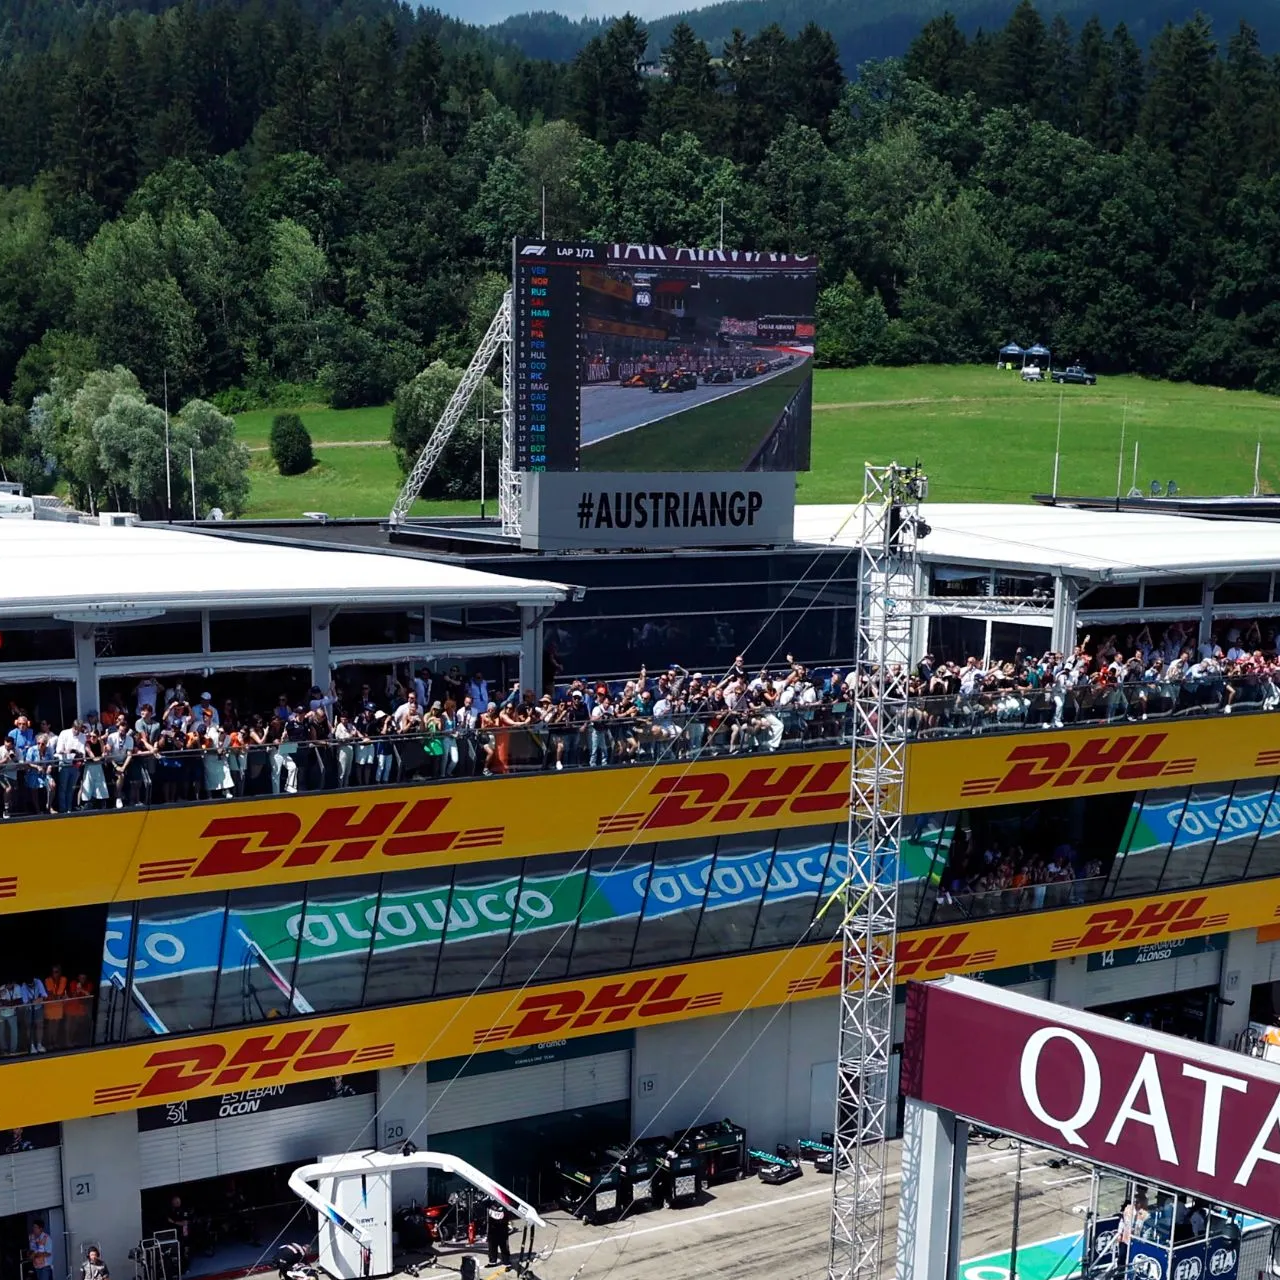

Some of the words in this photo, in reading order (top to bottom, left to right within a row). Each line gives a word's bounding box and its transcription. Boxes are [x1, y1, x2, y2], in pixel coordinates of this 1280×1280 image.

[557, 247, 573, 256] LAP
[576, 248, 594, 258] 1/71
[531, 267, 546, 275] VER
[531, 277, 548, 285] NOR
[531, 288, 547, 296] RUS
[531, 330, 544, 338] PIA
[577, 491, 763, 529] #AUSTRIANGP
[996, 734, 1167, 793] DHL
[641, 762, 860, 828] DHL
[192, 798, 459, 876] DHL
[1078, 897, 1206, 947] DHL
[1138, 938, 1186, 953] FERNANDO
[820, 932, 974, 988] DHL
[1102, 951, 1114, 967] 14
[1135, 949, 1172, 963] ALONSO
[509, 974, 694, 1038] DHL
[538, 1038, 567, 1050] aramco
[138, 1025, 356, 1097] DHL
[643, 1080, 654, 1092] 19
[221, 1084, 286, 1104] ESTEBAN
[219, 1100, 261, 1117] OCON
[388, 1126, 403, 1139] 20
[75, 1182, 91, 1196] 21
